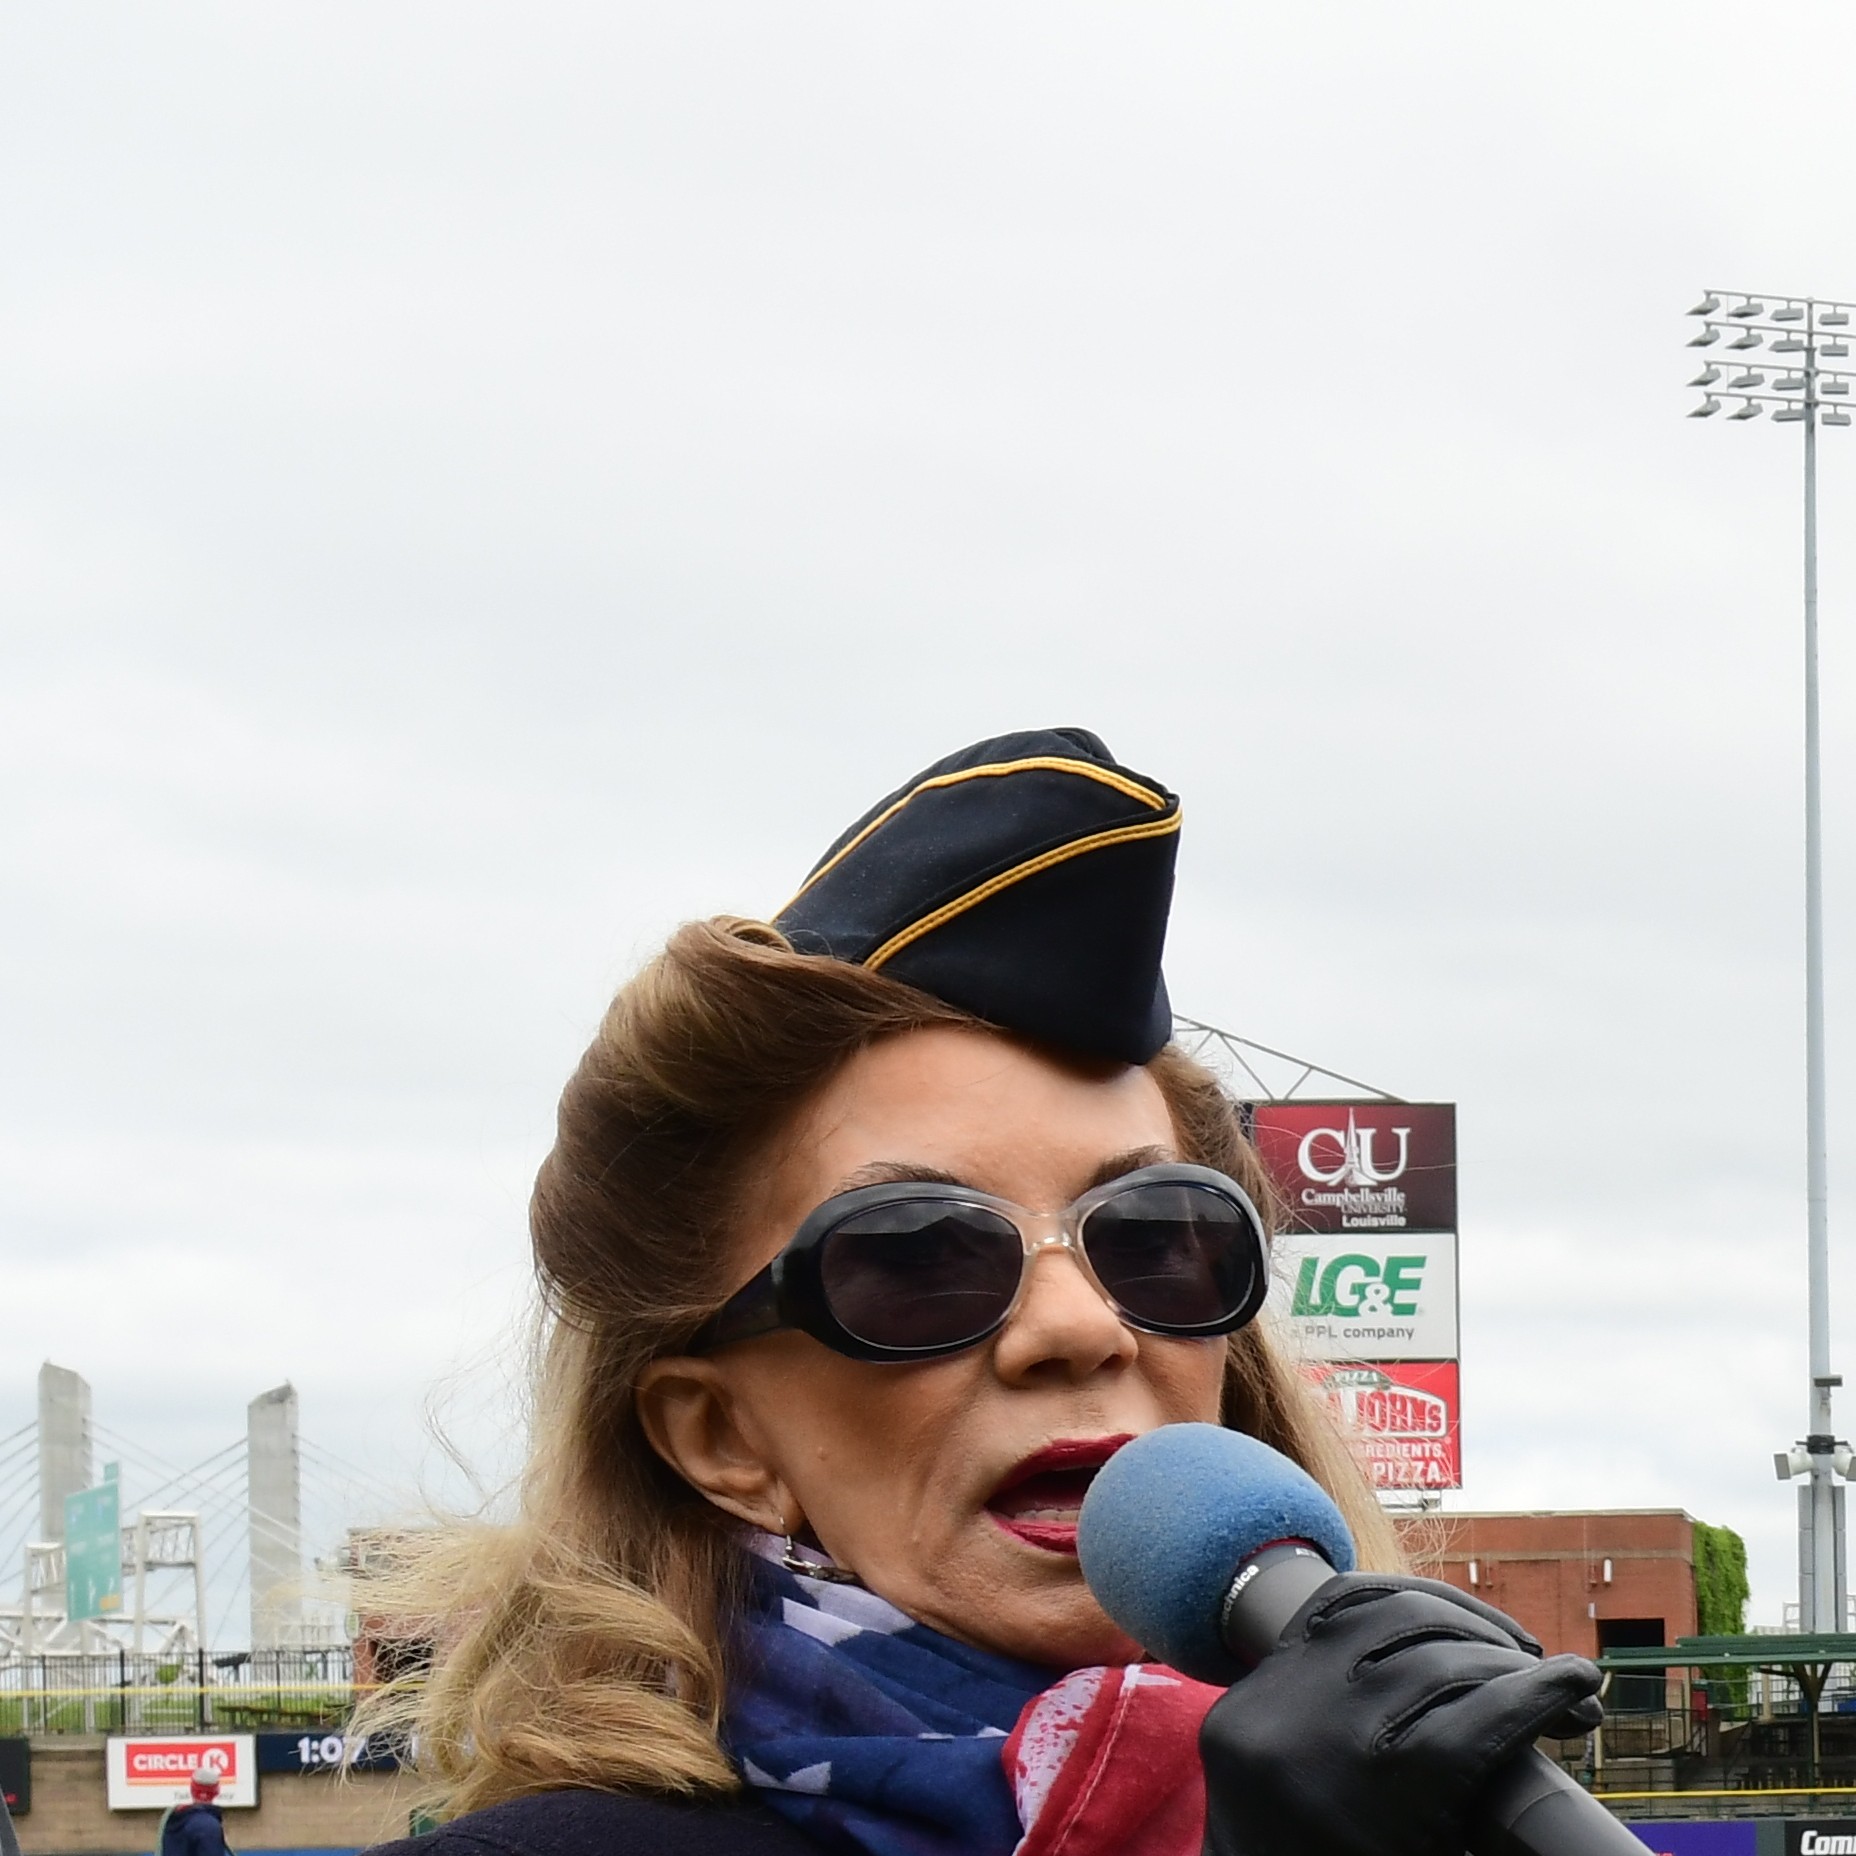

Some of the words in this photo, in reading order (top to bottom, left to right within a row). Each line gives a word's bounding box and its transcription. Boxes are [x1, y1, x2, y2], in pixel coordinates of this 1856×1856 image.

[1301, 1187, 1406, 1208] Campbellsville
[1342, 1215, 1406, 1228] Louisville
[1291, 1253, 1427, 1319] LG&E
[1343, 1327, 1415, 1340] company
[297, 1736, 366, 1764] 1:07
[133, 1753, 198, 1771] CIRCLE
